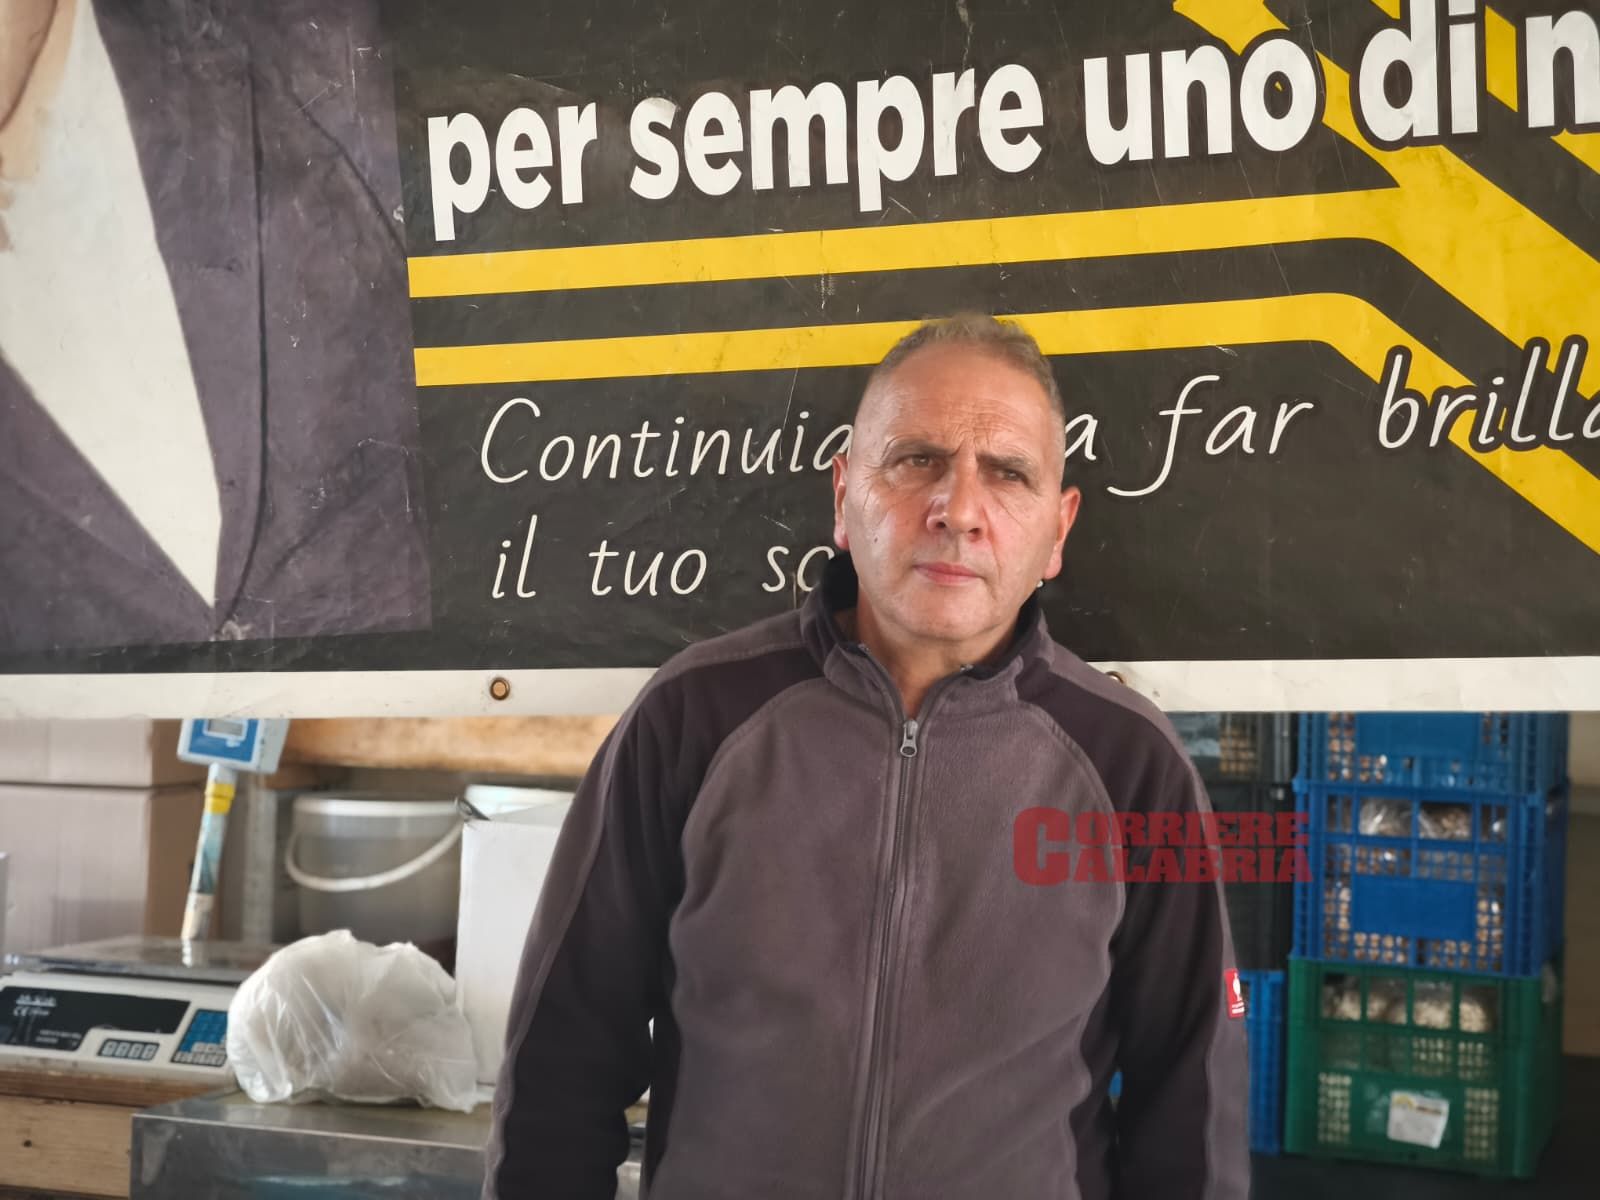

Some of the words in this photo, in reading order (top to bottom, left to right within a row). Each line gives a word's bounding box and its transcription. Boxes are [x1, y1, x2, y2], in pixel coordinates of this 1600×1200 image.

[427, 102, 598, 242] per
[629, 63, 1044, 213] sempre
[1083, 38, 1317, 165] uno
[1358, 0, 1478, 142] di
[481, 397, 854, 484] Continuia
[1106, 374, 1314, 497] far
[491, 514, 538, 599] il
[588, 539, 707, 597] tuo
